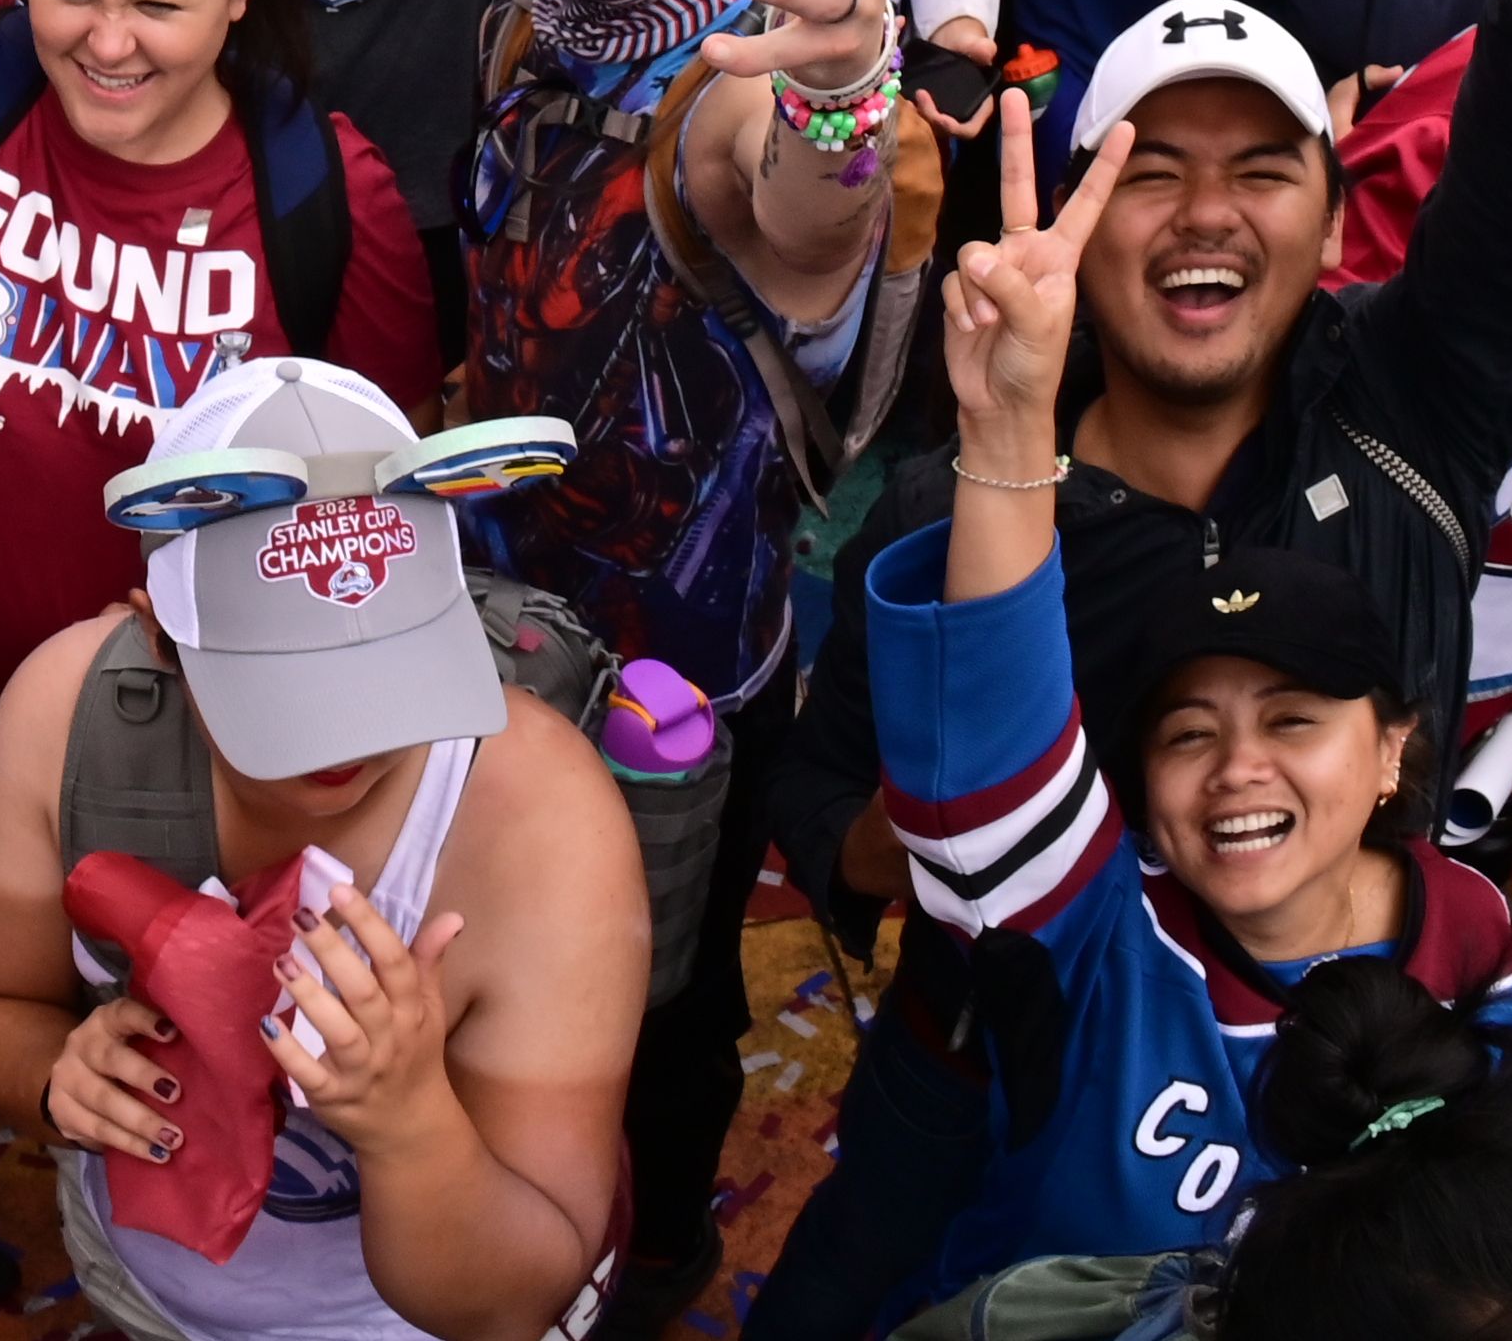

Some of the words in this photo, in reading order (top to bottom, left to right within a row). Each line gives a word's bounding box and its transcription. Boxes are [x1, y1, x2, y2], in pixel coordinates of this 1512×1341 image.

[315, 499, 358, 517] 2022
[273, 512, 363, 546] STANLEY
[364, 509, 399, 531] CUP
[262, 525, 414, 574] CHAMPIONS
